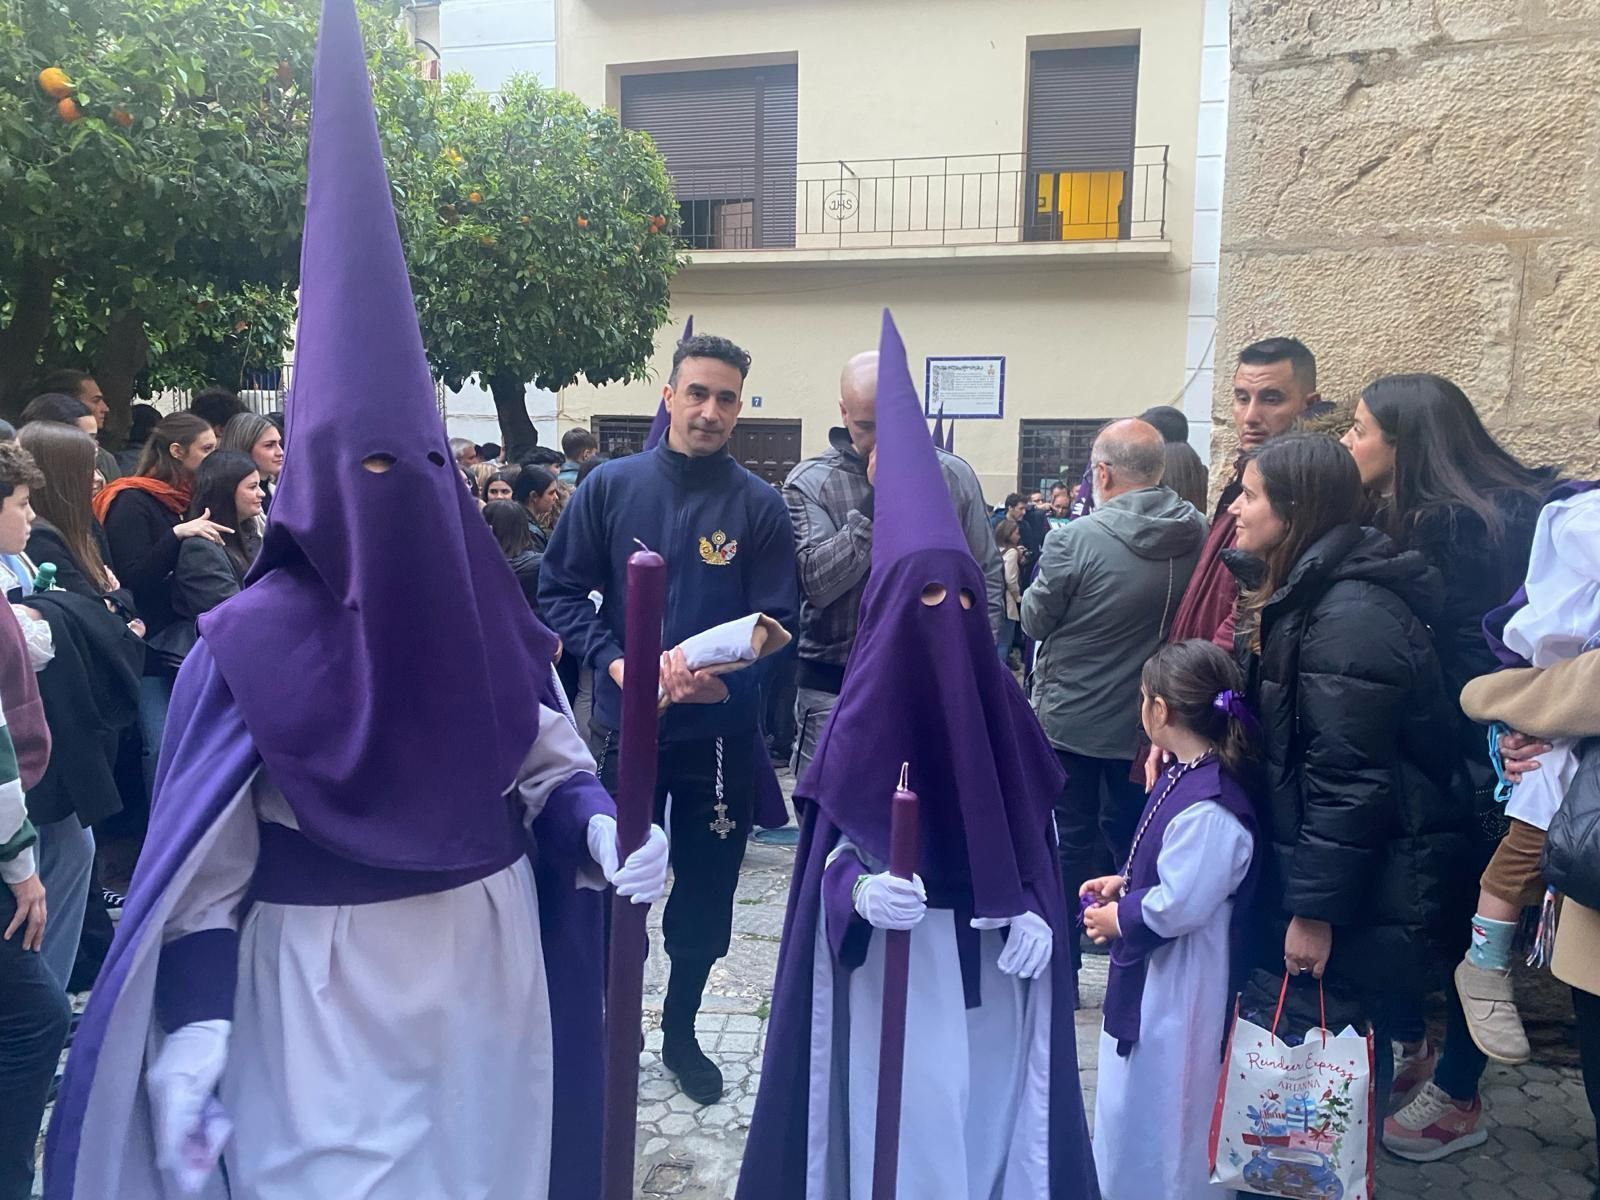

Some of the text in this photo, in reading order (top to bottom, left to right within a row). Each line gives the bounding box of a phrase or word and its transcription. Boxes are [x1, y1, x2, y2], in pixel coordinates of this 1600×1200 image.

[1246, 1052, 1359, 1081] Reindeer Express
[1278, 1079, 1320, 1092] ARIANNA
